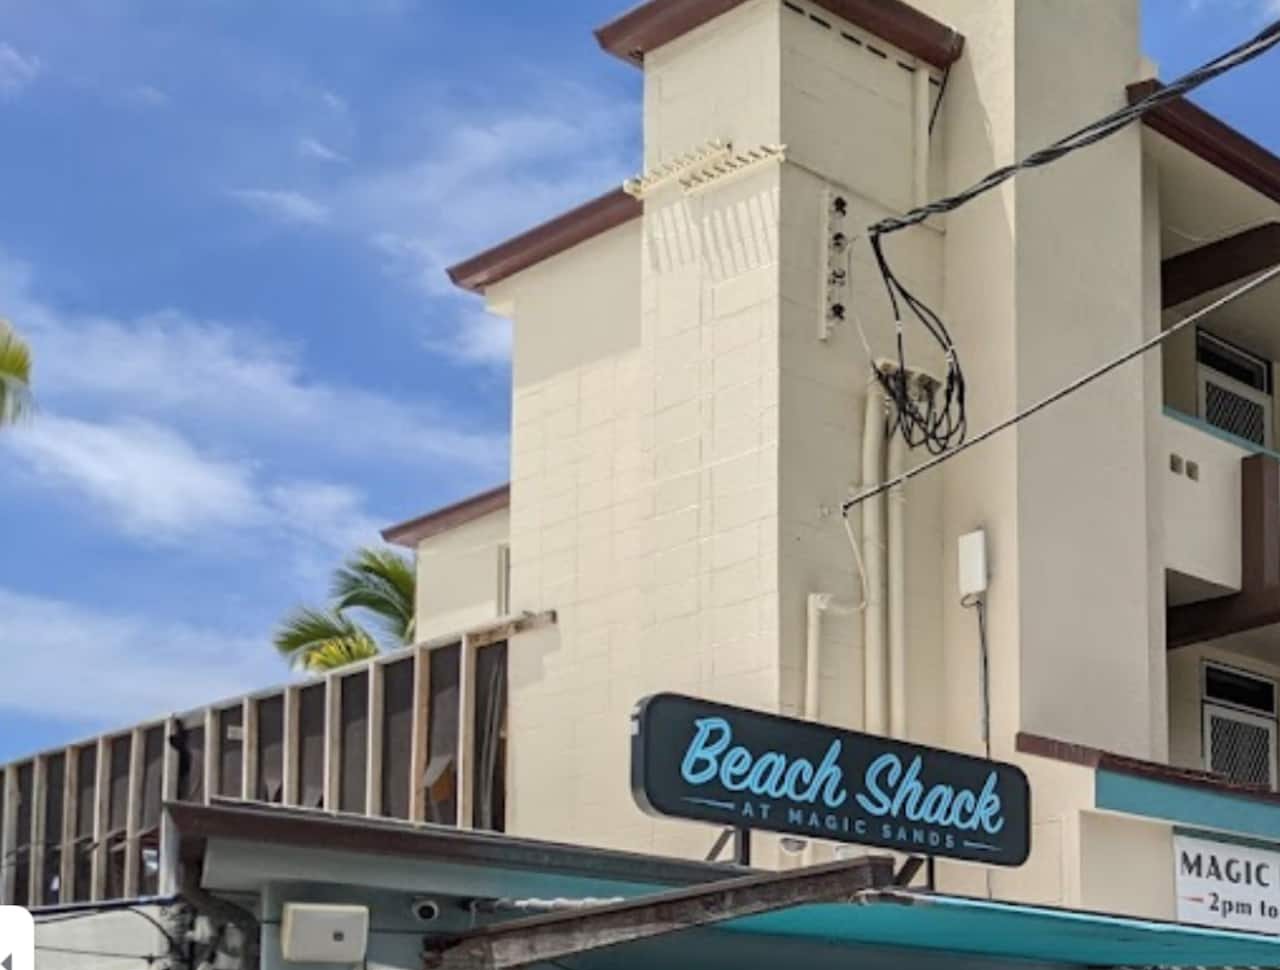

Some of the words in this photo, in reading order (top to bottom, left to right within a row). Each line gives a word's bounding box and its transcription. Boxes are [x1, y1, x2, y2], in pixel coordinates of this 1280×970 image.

[680, 716, 847, 808] Beach
[855, 753, 1004, 834] Shack
[742, 801, 770, 819] AT
[788, 809, 867, 834] MAGIC
[881, 823, 956, 849] SANDS
[1180, 850, 1270, 887] MAGIC
[1208, 892, 1252, 918] 2pm
[1260, 900, 1278, 919] to
